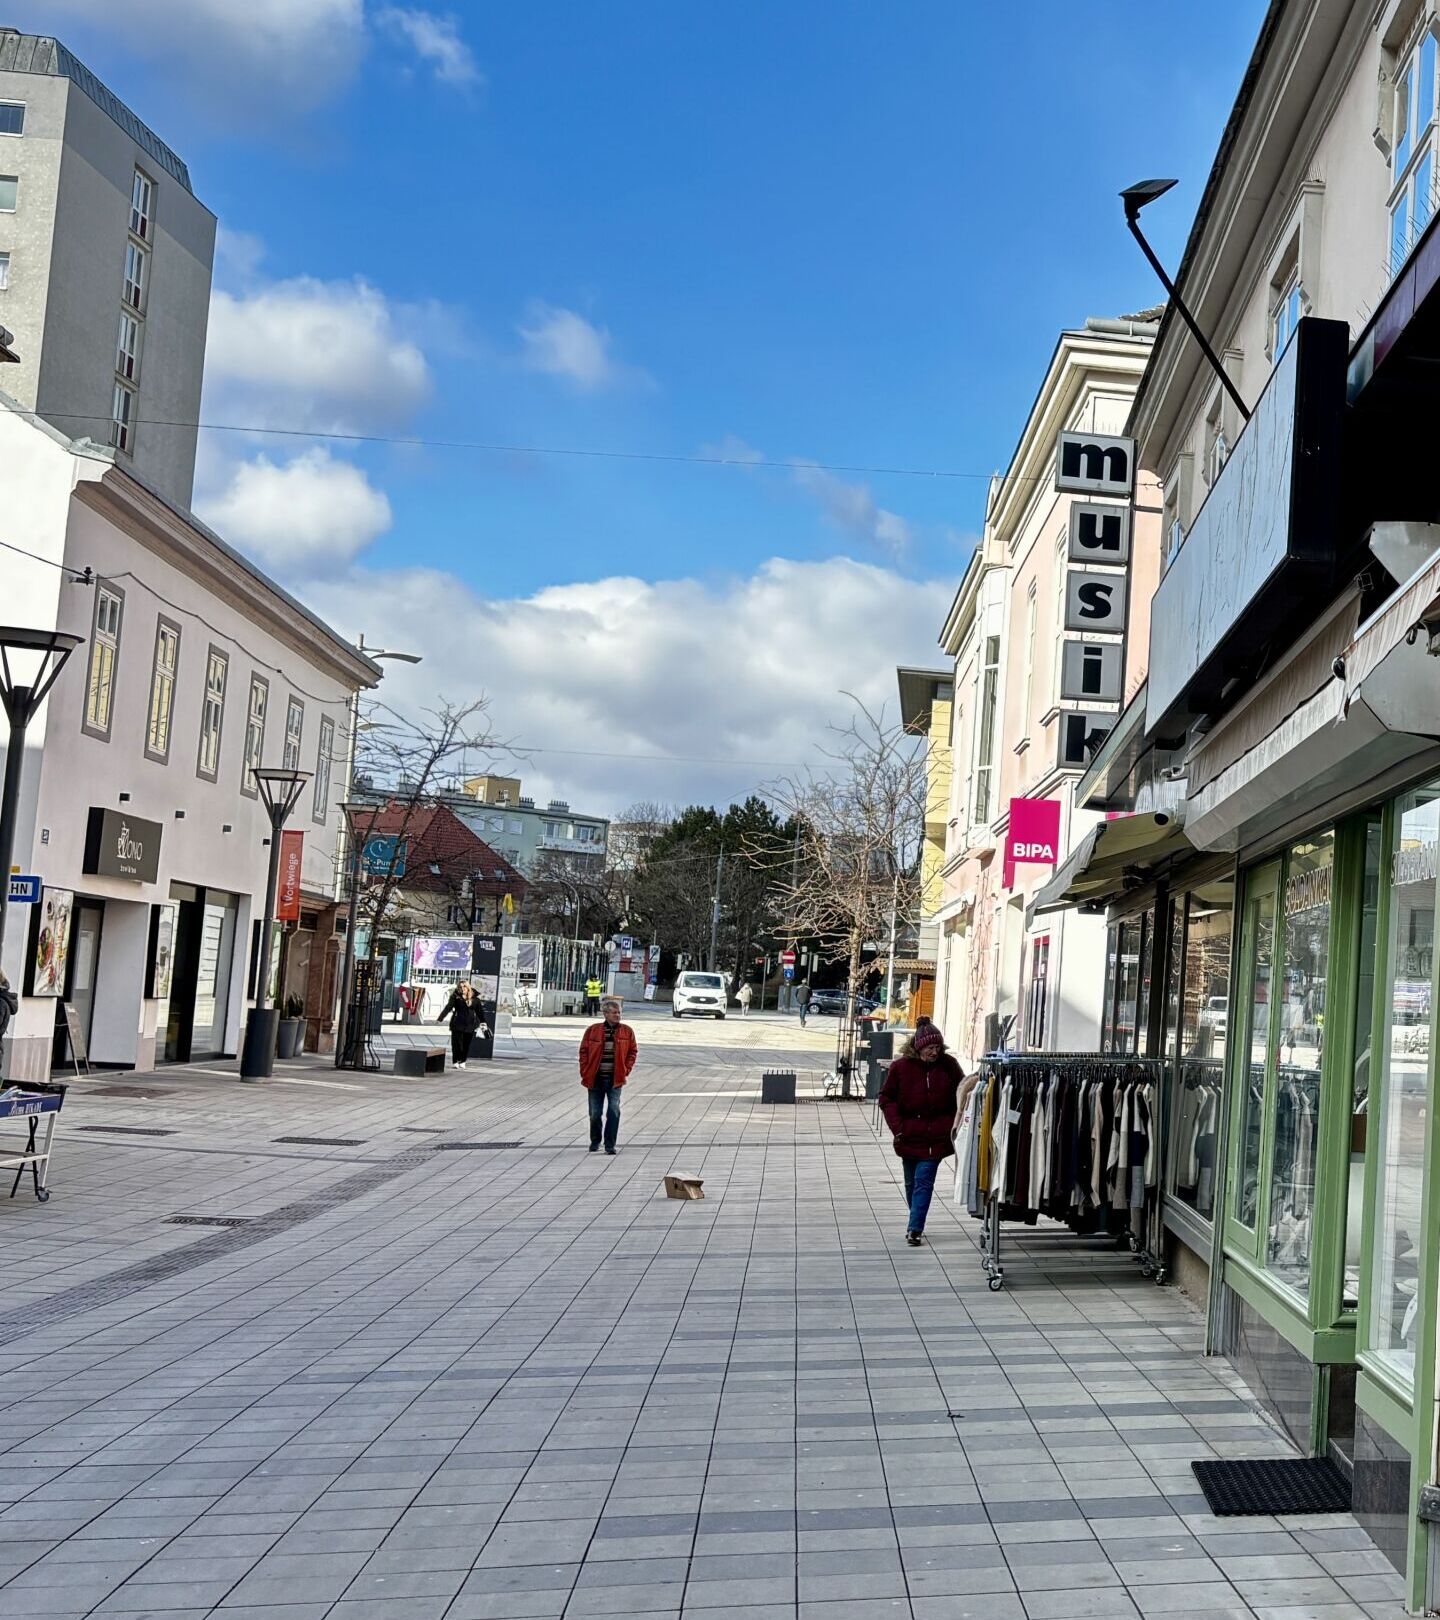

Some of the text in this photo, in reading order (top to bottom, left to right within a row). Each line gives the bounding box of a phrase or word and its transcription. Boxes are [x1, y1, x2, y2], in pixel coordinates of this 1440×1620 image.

[1062, 441, 1128, 763] musik
[1013, 842, 1054, 859] BIPA
[10, 882, 28, 895] HN
